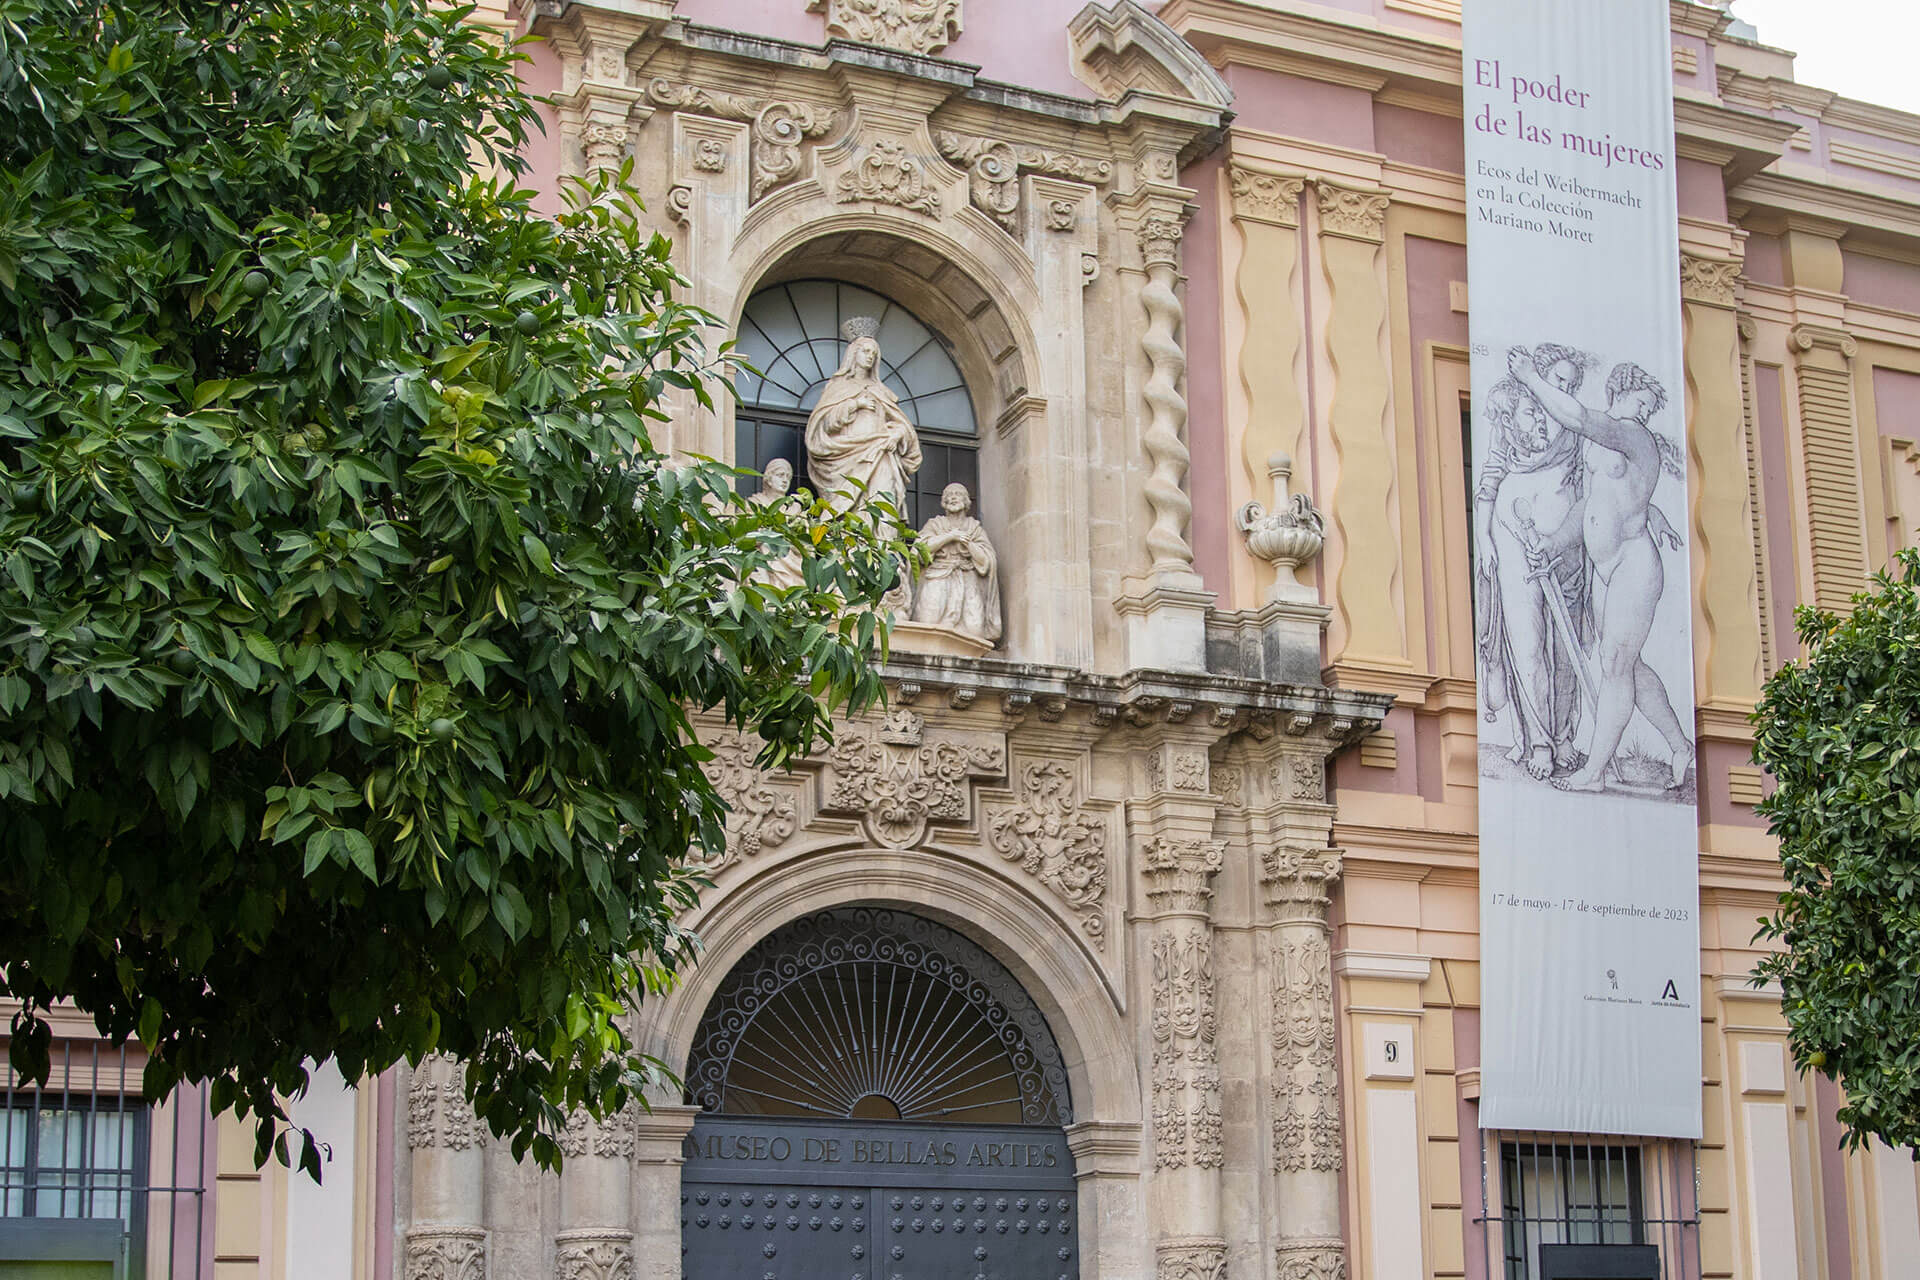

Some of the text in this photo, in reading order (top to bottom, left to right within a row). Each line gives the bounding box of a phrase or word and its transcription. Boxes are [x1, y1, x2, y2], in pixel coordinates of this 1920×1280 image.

[1475, 59, 1591, 109] El poder
[1475, 104, 1664, 170] de las mujeres
[1477, 159, 1642, 209] Ecos del Weibermacht
[1477, 186, 1593, 221] en la Colección
[1478, 206, 1593, 244] Mariano Moret
[1492, 893, 1505, 905] 17
[1507, 893, 1520, 907] de
[1522, 898, 1551, 912] mayo
[1562, 899, 1574, 911] 17
[1577, 899, 1590, 913] de
[1592, 902, 1647, 918] septiembre
[1649, 906, 1661, 919] de
[1664, 908, 1689, 922] 2023
[1386, 1042, 1396, 1063] 9
[683, 1134, 1057, 1168] MUSEO DE BELLAS ARTES
